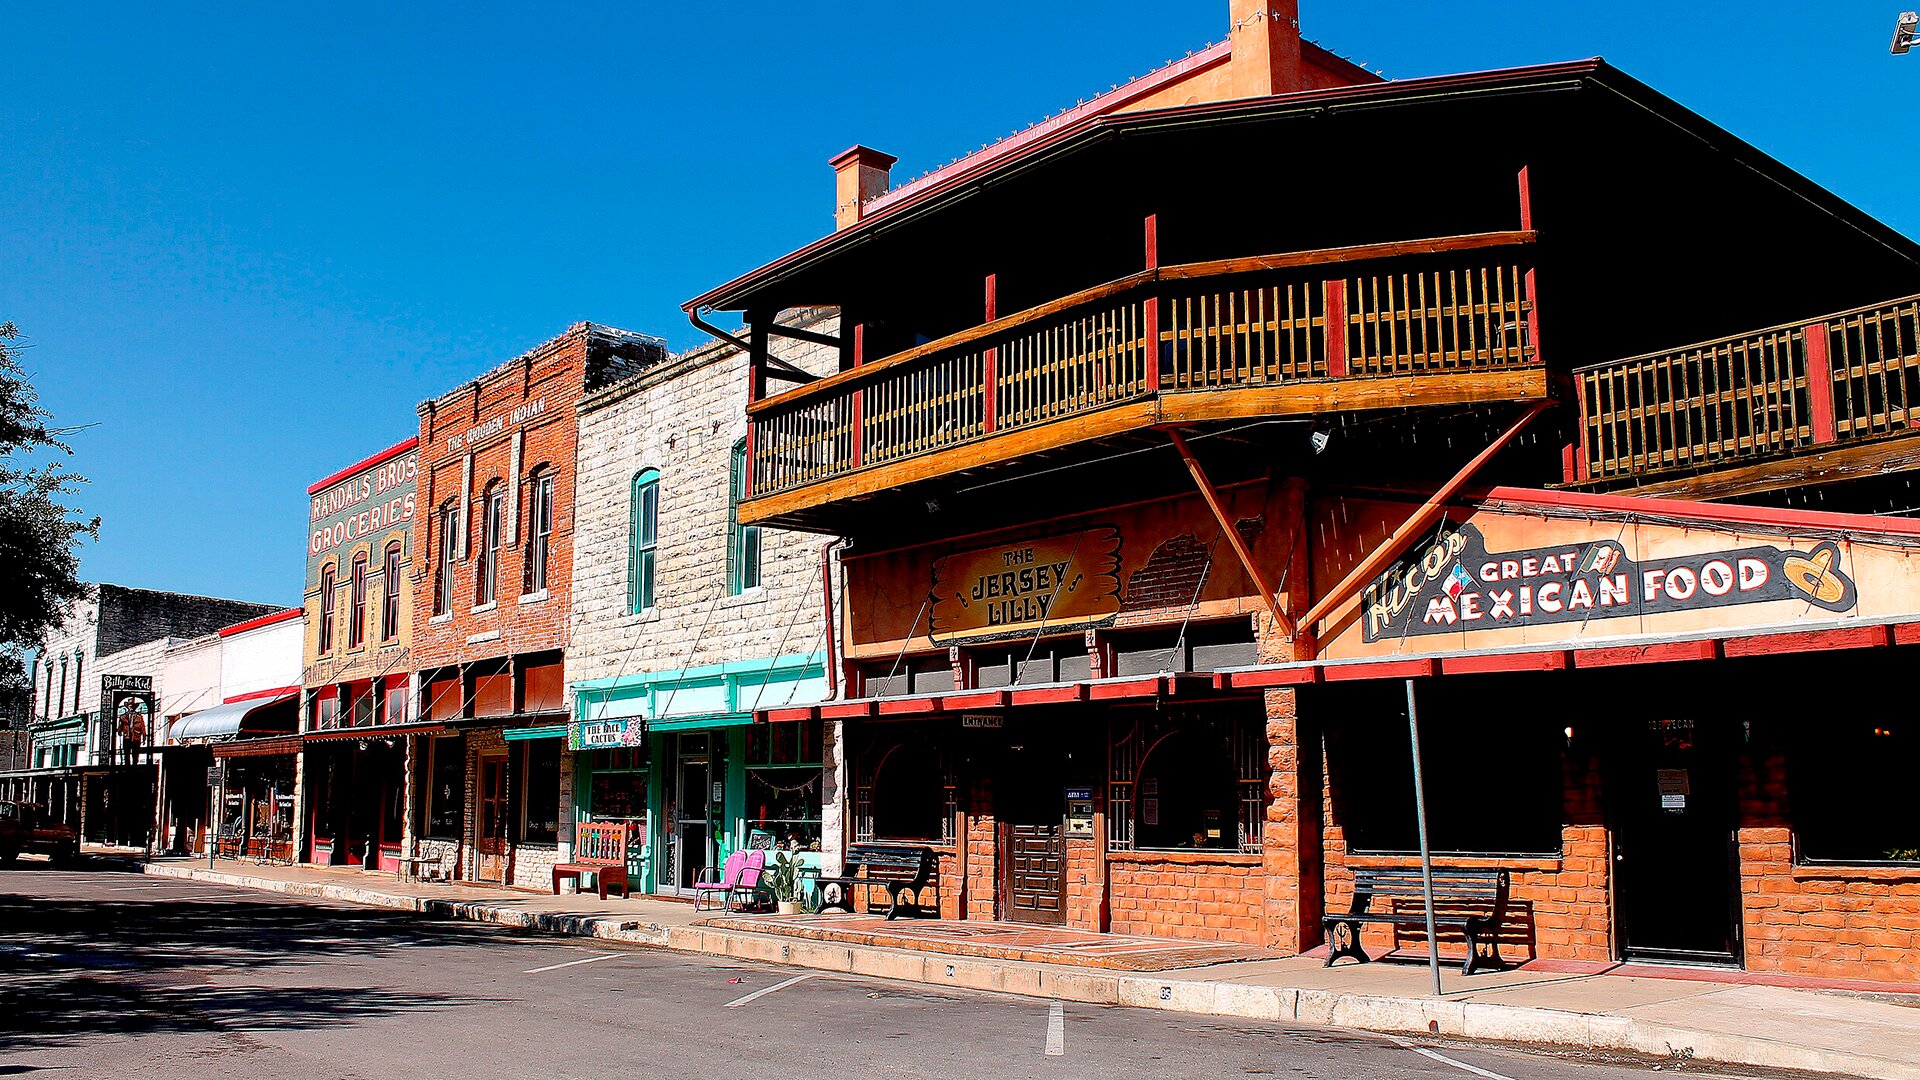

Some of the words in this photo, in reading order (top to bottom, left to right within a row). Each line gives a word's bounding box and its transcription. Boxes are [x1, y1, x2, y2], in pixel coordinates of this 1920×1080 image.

[447, 434, 463, 453] THE
[466, 415, 504, 444] WOODEN
[509, 396, 546, 426] INDIAN
[312, 474, 371, 522] RANDALS
[310, 491, 417, 557] GROCERIES
[1003, 547, 1034, 567] THE
[1479, 552, 1578, 582] GREAT
[971, 561, 1069, 601] JERSEY
[1643, 558, 1770, 602] FOOD
[987, 593, 1052, 627] LILLY
[1422, 573, 1628, 627] MEXICAN
[104, 675, 125, 690] Billy
[134, 677, 151, 690] Kid
[587, 725, 601, 735] THE
[591, 733, 616, 744] CACTUS
[946, 965, 955, 976] 84
[1160, 987, 1171, 1000] 85
